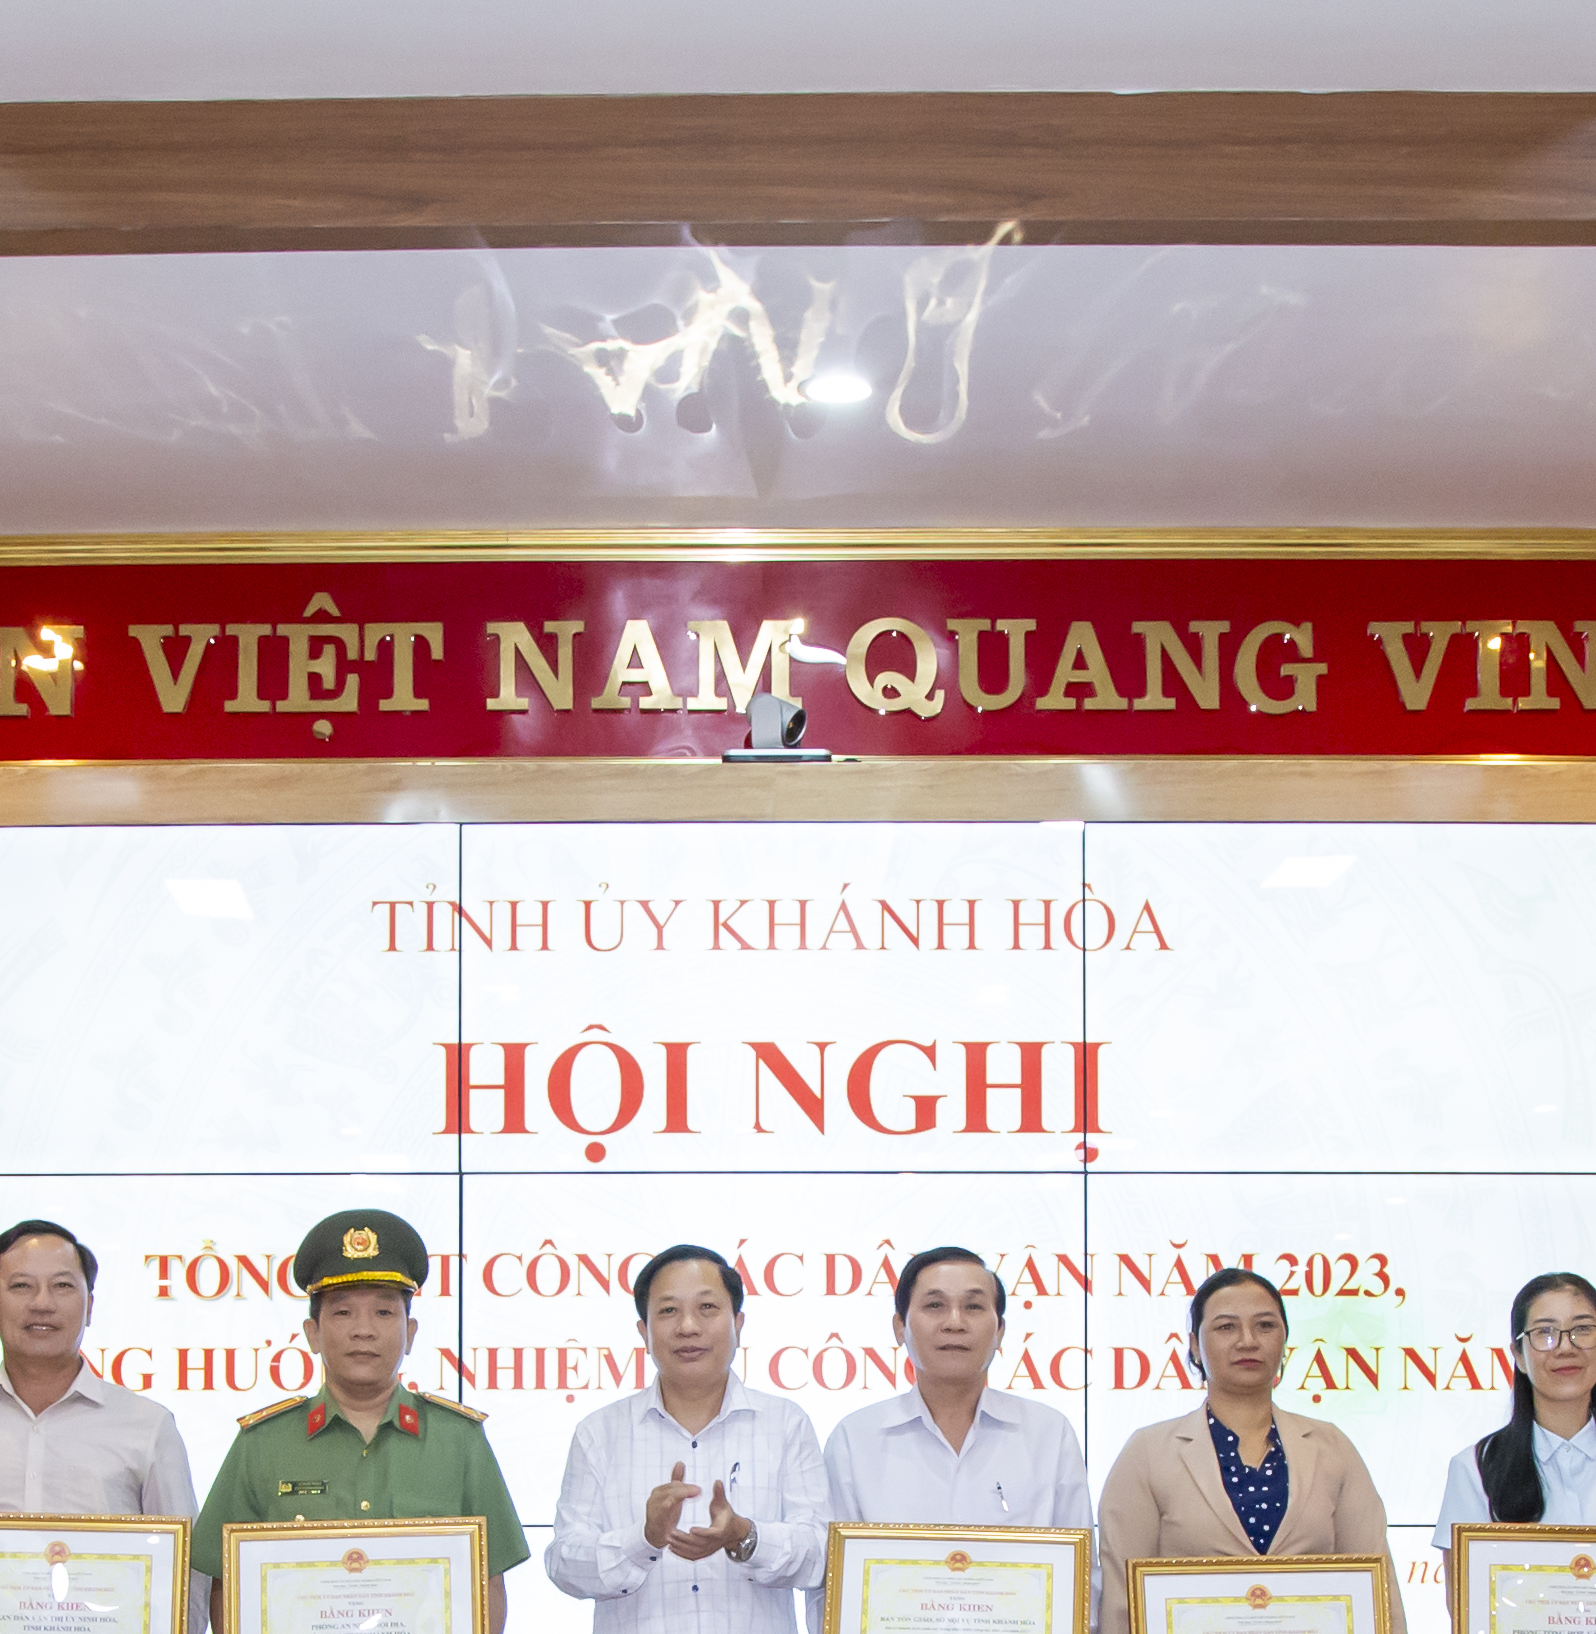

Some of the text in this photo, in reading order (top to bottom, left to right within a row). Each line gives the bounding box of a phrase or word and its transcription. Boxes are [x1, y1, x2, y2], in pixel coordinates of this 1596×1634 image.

[128, 592, 444, 740] VIỆT
[485, 617, 803, 712] NAM
[846, 617, 1327, 720] QUANG
[371, 881, 1174, 953] TỈNH ỦY KHÁNH HÒA
[431, 1024, 1113, 1164] HỘI NGHỊ
[733, 1238, 804, 1297] ÁC
[824, 1238, 917, 1297] DÂ
[1274, 1252, 1406, 1309] 2023,
[768, 1332, 917, 1391] CÔN
[986, 1332, 1094, 1391] ÁC
[1108, 1332, 1208, 1391] DÂ
[959, 1603, 994, 1612] KHEN
